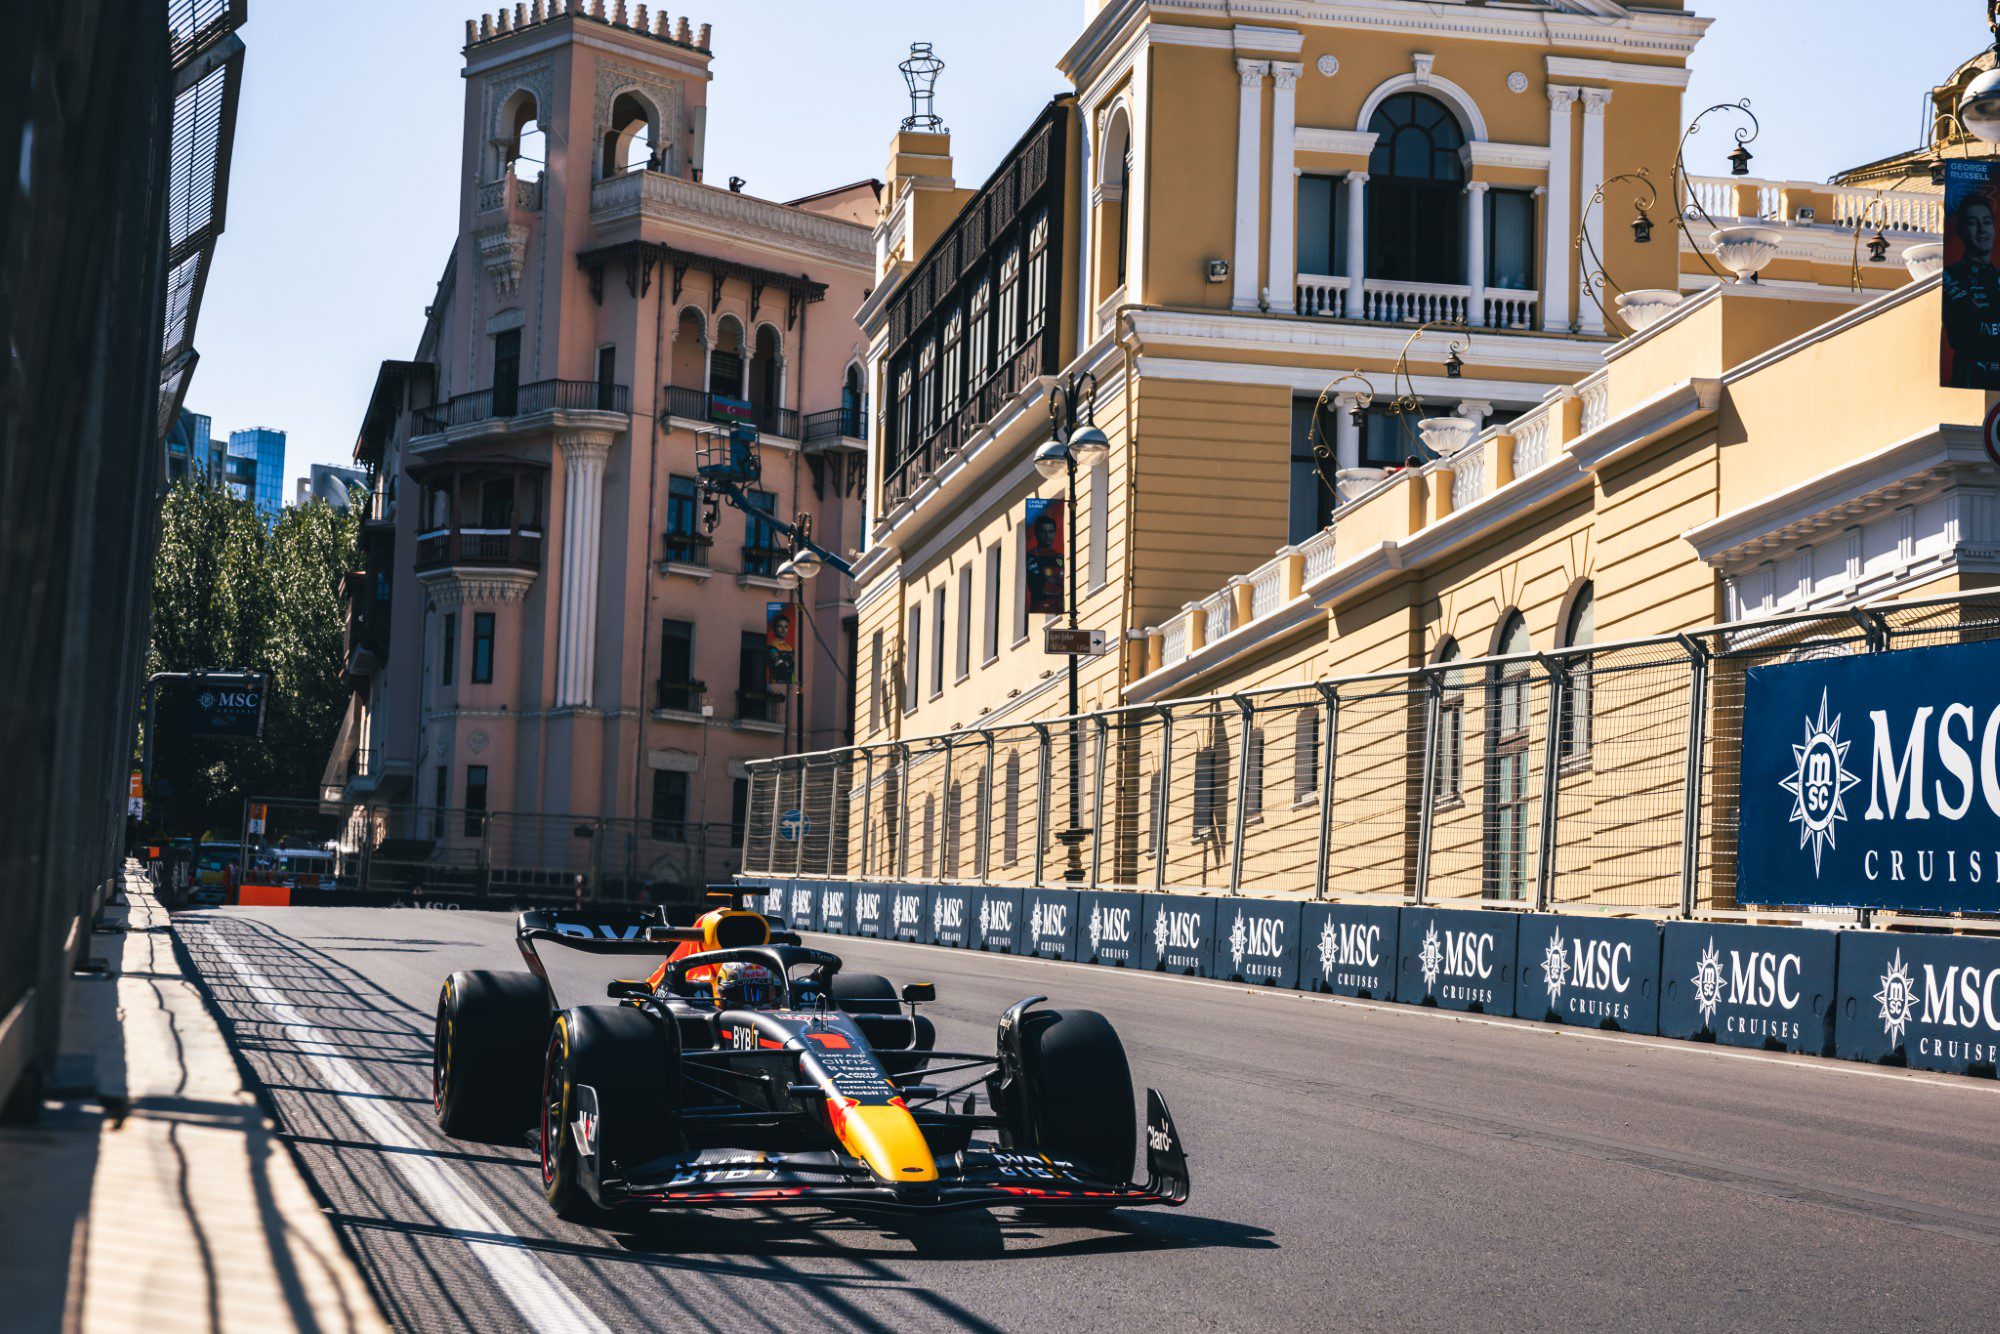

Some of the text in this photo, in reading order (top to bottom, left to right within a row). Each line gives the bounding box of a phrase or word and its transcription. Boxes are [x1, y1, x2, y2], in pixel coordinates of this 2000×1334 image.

[1951, 163, 1987, 172] GEORGE
[1951, 171, 1989, 181] RUSSELL
[219, 692, 259, 708] MSC
[797, 889, 812, 914] MSC
[829, 891, 844, 917] MSC
[863, 893, 880, 920] MSC
[901, 895, 920, 924] MSC
[943, 897, 963, 928] MSC
[990, 900, 1013, 932] MSC
[1042, 903, 1067, 937] MSC
[1102, 907, 1130, 942] MSC
[1169, 911, 1200, 949] MSC
[1247, 917, 1284, 958] MSC
[1101, 947, 1129, 960] CRUISES
[1338, 923, 1380, 968] MSC
[1444, 930, 1494, 980] MSC
[1168, 954, 1199, 968] CRUISES
[1246, 963, 1282, 978] CRUISES
[1571, 938, 1631, 993] MSC
[1337, 973, 1378, 989] CRUISES
[1727, 950, 1800, 1010] MSC
[1443, 985, 1492, 1004] CRUISES
[1570, 997, 1629, 1020] CRUISES
[733, 1022, 759, 1051] BYBIT
[804, 1033, 851, 1049] 1
[1727, 1016, 1799, 1040] CRUISES
